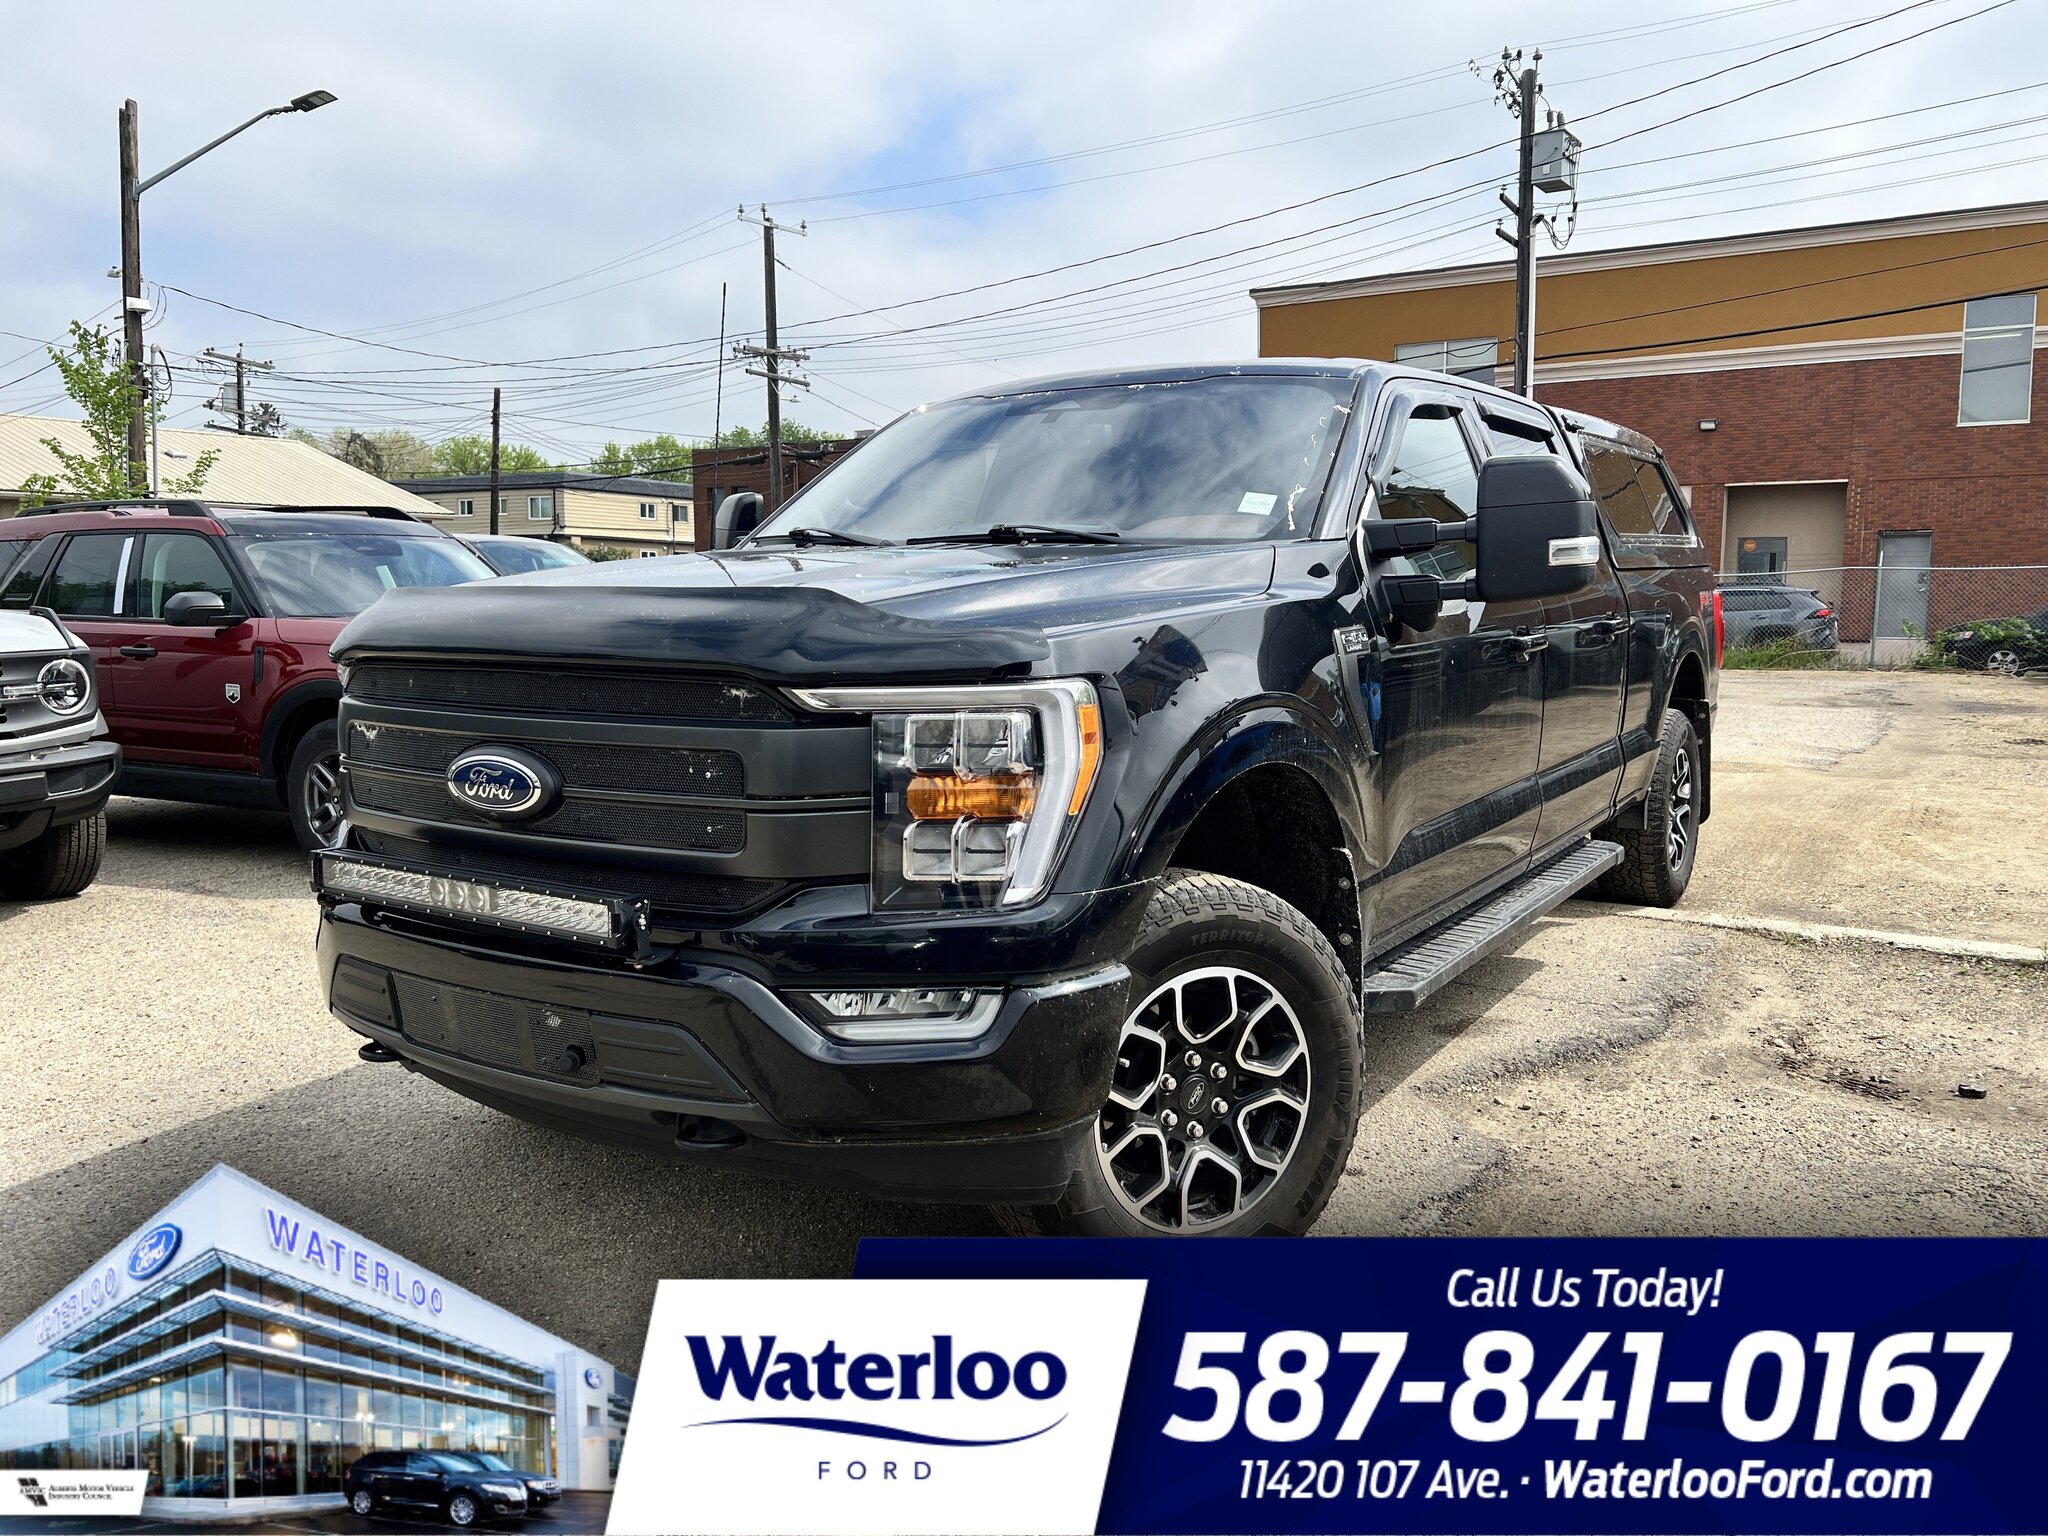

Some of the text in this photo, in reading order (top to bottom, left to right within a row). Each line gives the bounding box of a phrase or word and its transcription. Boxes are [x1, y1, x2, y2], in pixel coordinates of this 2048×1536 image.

[464, 766, 515, 800] Ford
[1190, 929, 1275, 948] TERRITORY
[1294, 1015, 1354, 1218] GOODYEAR
